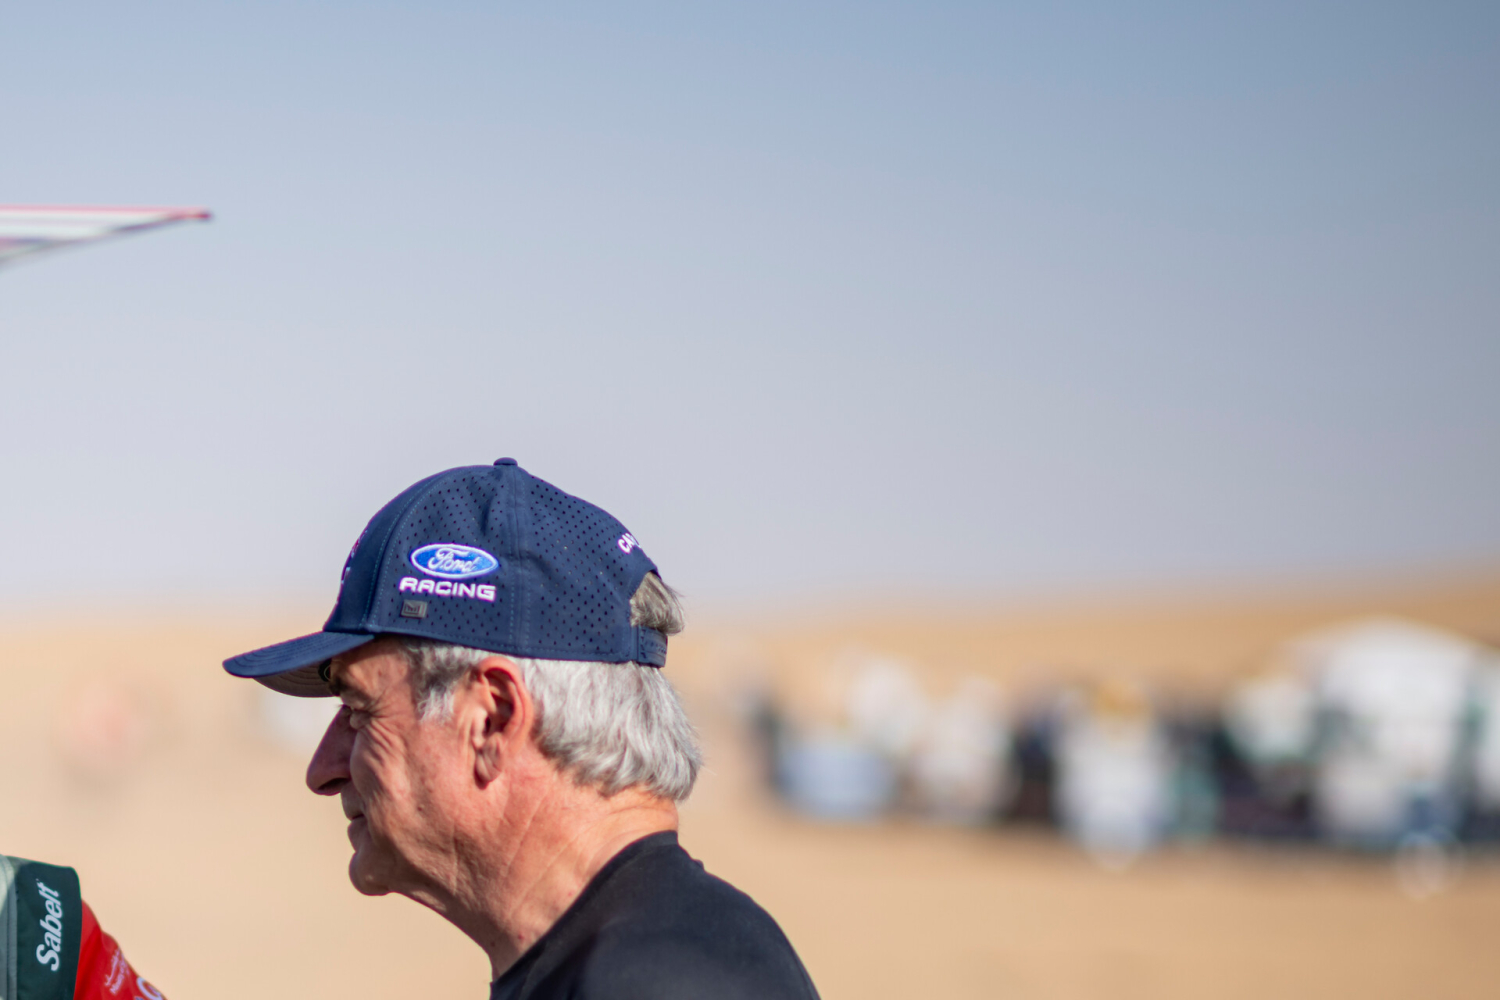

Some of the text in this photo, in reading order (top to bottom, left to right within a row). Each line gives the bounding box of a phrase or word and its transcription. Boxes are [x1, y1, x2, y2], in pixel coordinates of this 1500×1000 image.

[428, 547, 481, 573] Ford
[399, 576, 496, 602] RACING
[35, 880, 63, 972] Sabelt
